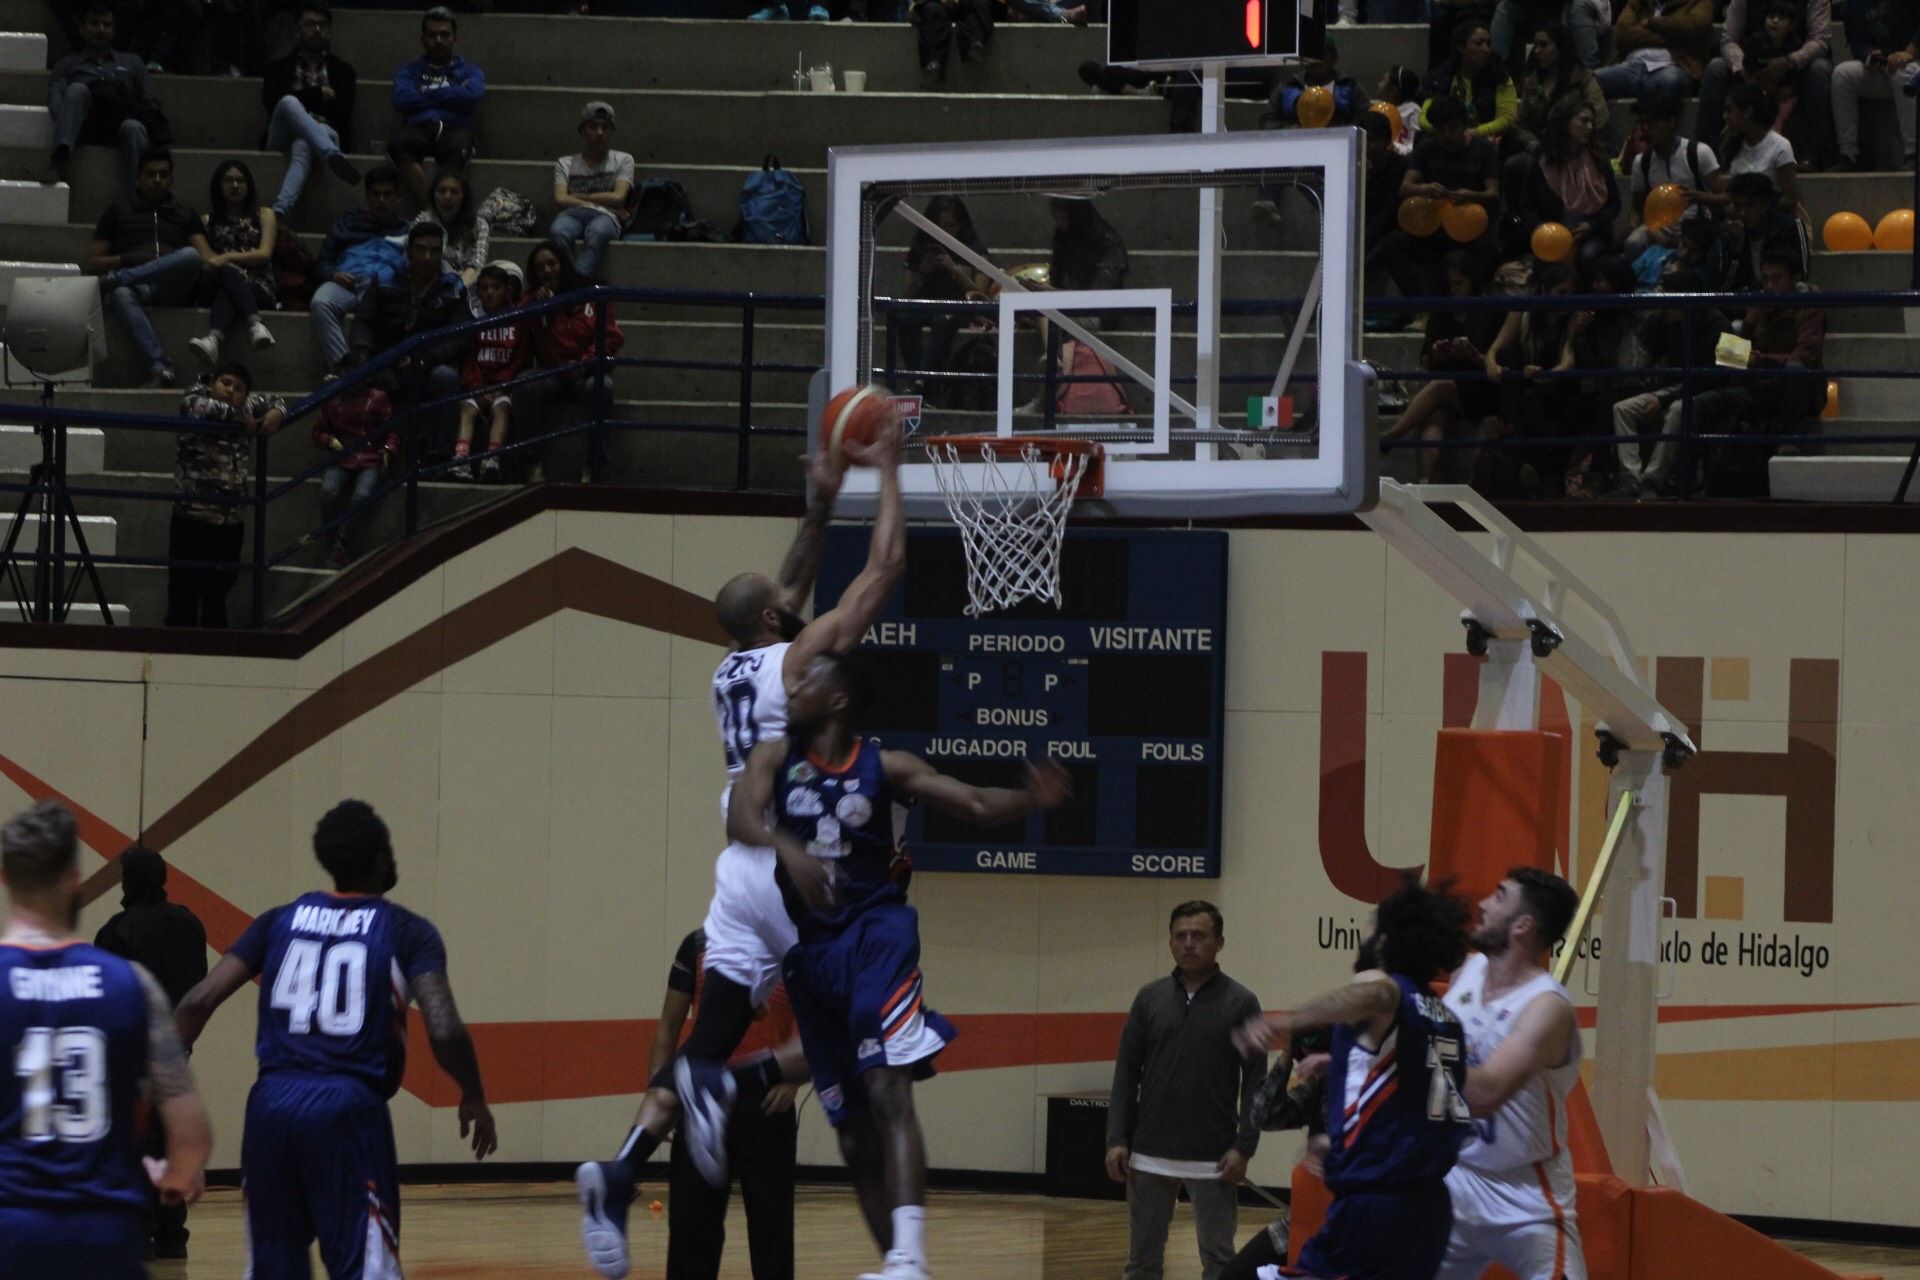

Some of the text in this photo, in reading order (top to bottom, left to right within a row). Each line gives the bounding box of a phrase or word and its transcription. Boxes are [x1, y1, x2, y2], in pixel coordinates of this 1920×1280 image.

[893, 401, 916, 413] NBP
[860, 622, 917, 646] AEH
[968, 635, 1066, 653] PERIODO
[1089, 626, 1213, 651] VISITANTE
[968, 672, 982, 690] P
[1044, 674, 1059, 692] P
[976, 708, 1049, 727] BONUS
[925, 738, 1028, 758] JUGADOR
[1047, 741, 1097, 760] FOUL
[1141, 742, 1205, 762] FOULS
[976, 850, 1038, 870] GAME
[1131, 854, 1206, 874] SCORE
[1701, 931, 1728, 966] de
[1738, 932, 1830, 978] Hidalgo
[270, 938, 368, 1036] 40
[14, 1025, 112, 1143] 13
